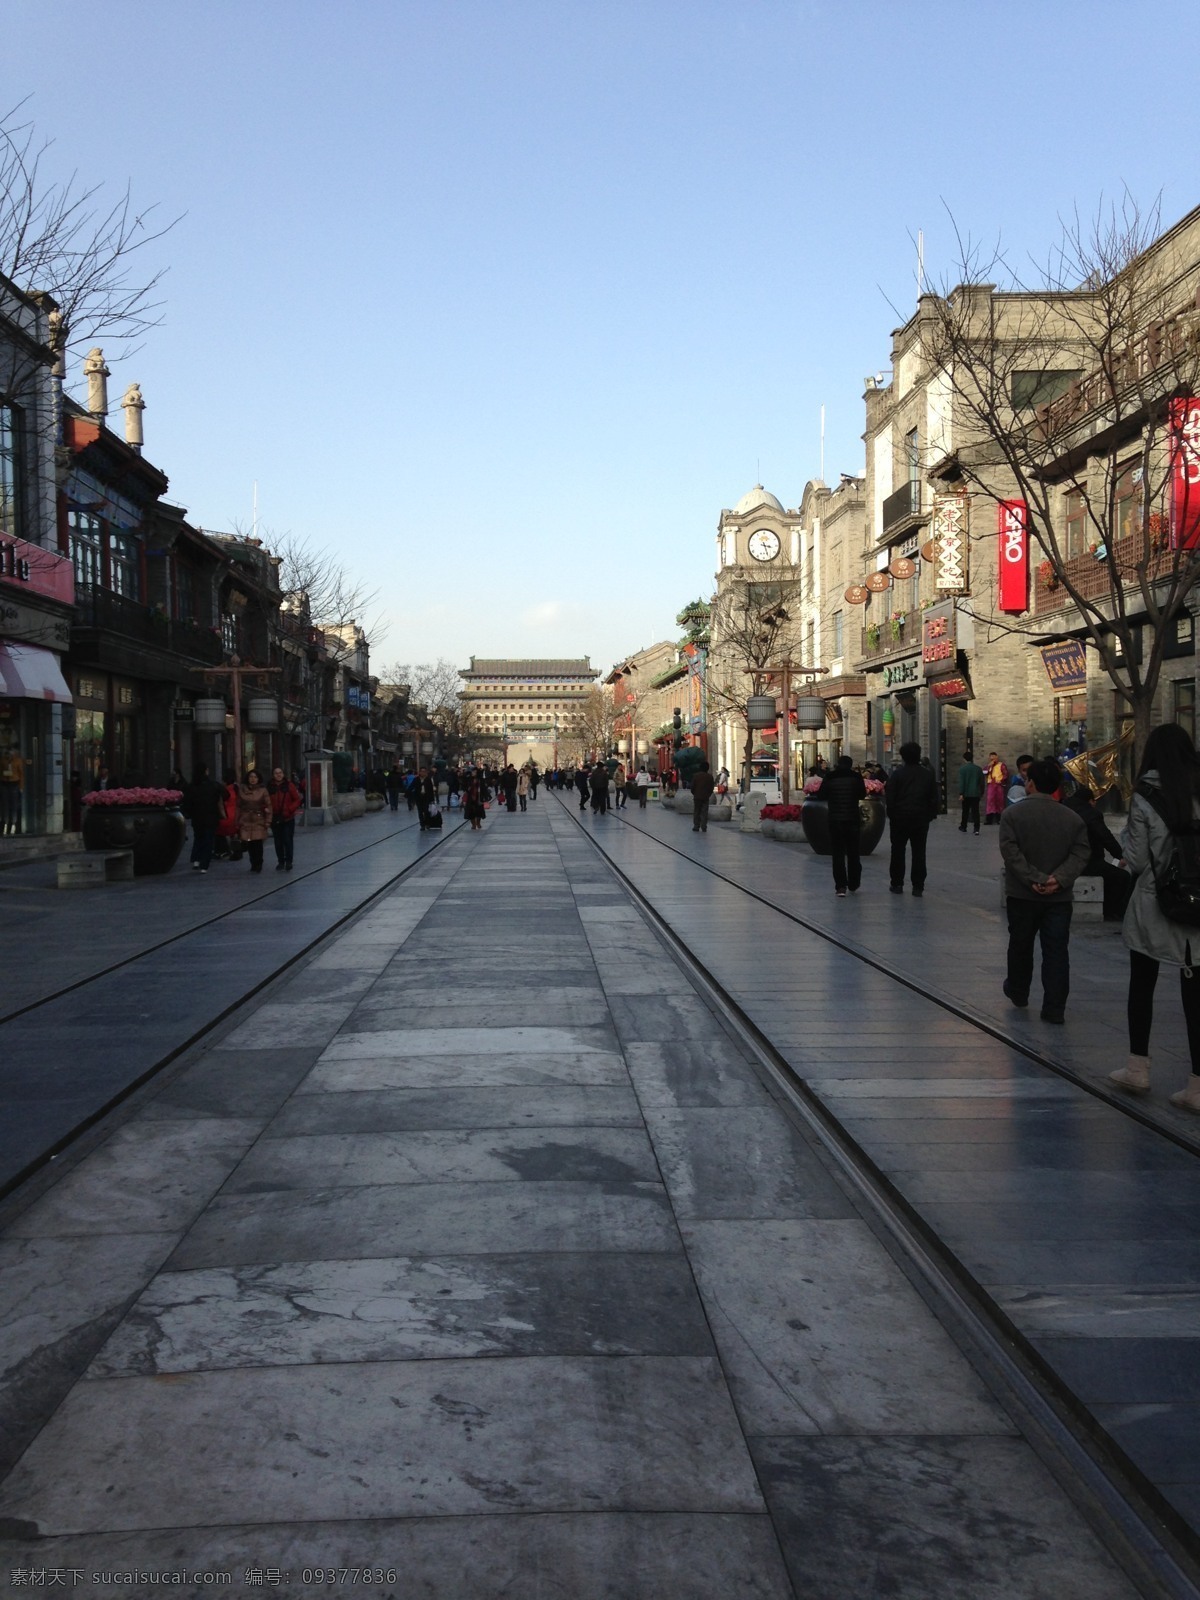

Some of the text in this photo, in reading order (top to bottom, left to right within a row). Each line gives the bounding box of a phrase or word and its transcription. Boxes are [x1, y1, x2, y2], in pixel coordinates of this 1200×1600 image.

[943, 509, 958, 577] 老北京小吃
[1005, 507, 1023, 563] SPAO
